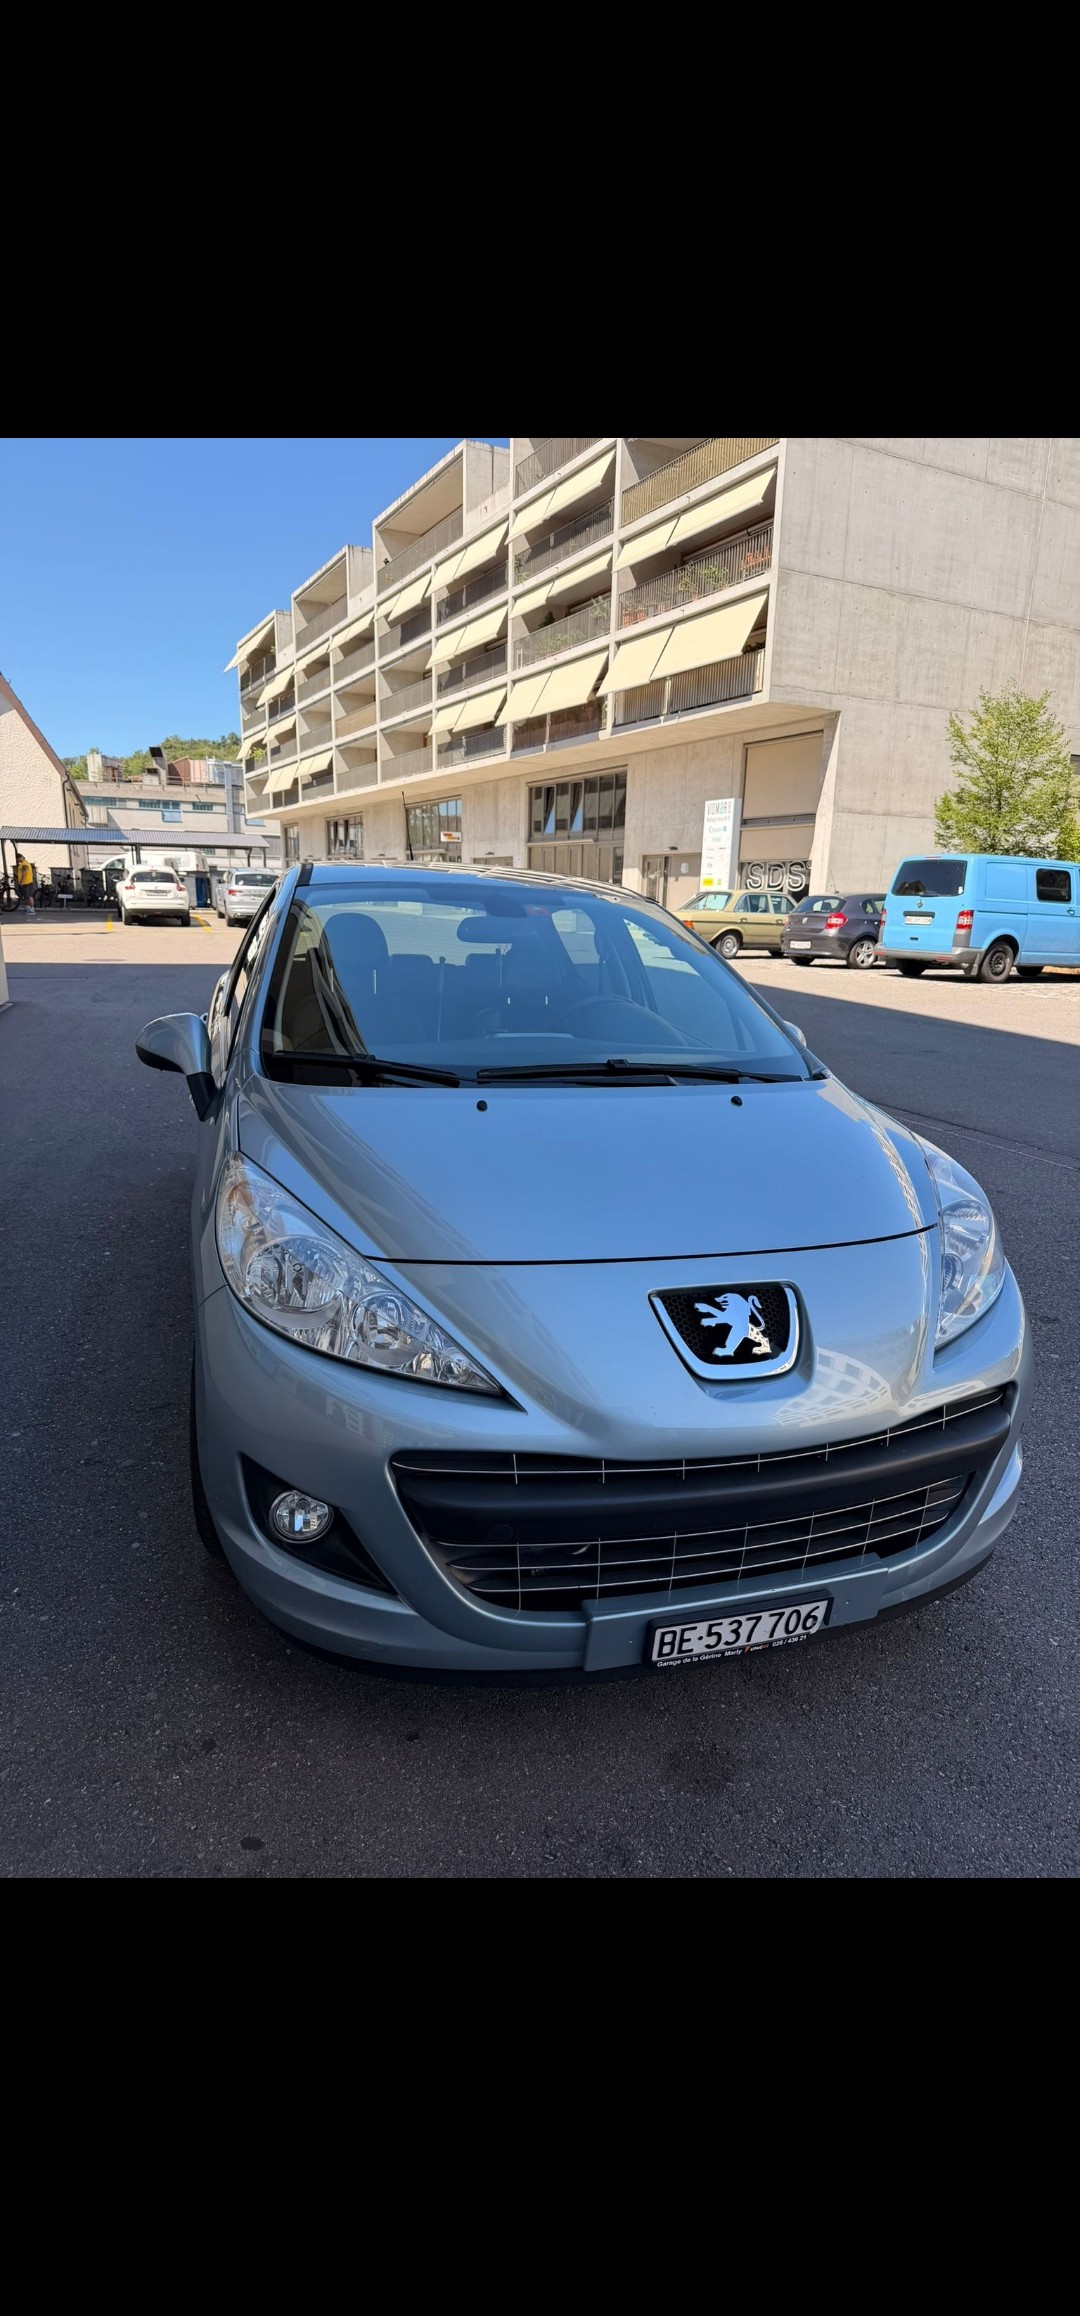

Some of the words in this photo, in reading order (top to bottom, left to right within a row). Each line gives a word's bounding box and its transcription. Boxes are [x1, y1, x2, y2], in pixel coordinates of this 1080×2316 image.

[656, 1659, 681, 1668] Garage
[682, 1656, 691, 1664] de
[700, 1652, 722, 1661] Gérine
[724, 1649, 743, 1657] Marly
